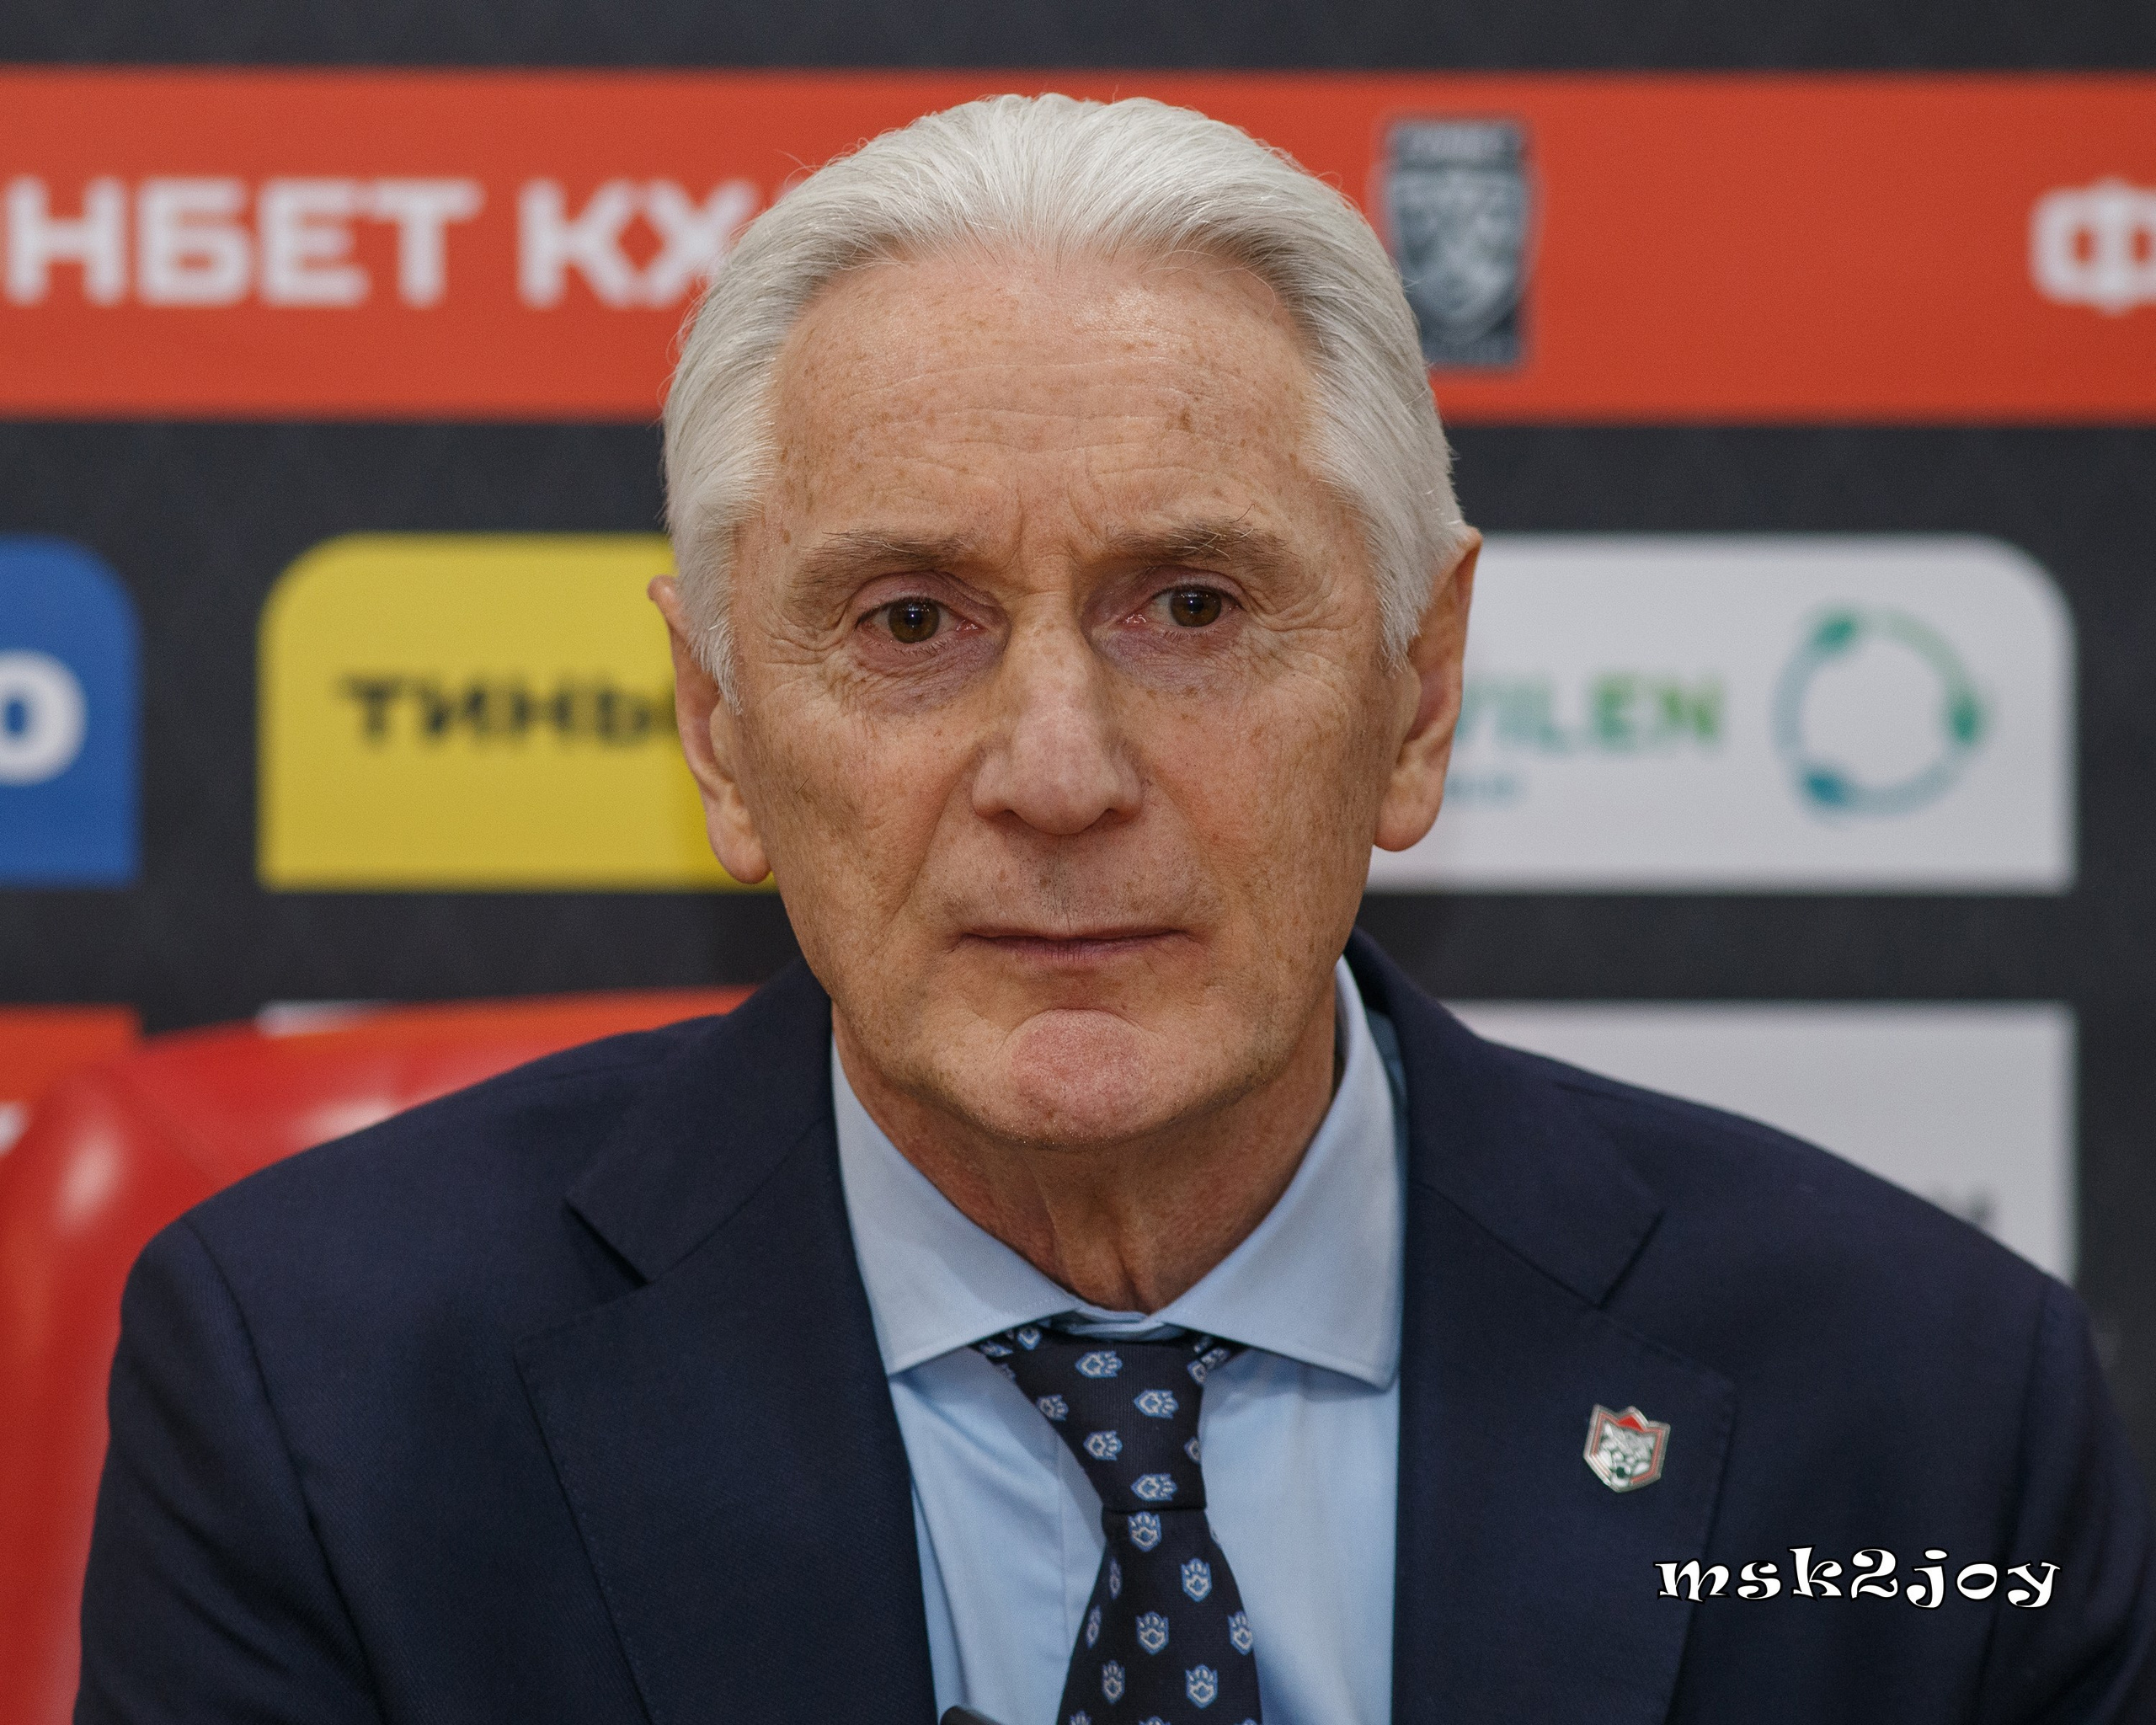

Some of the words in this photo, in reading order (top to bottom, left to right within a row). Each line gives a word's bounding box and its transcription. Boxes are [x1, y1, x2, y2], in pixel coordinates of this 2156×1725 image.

[3, 174, 483, 308] НБЕТ
[516, 176, 792, 311] КХ
[338, 670, 675, 751] ТИНЬ
